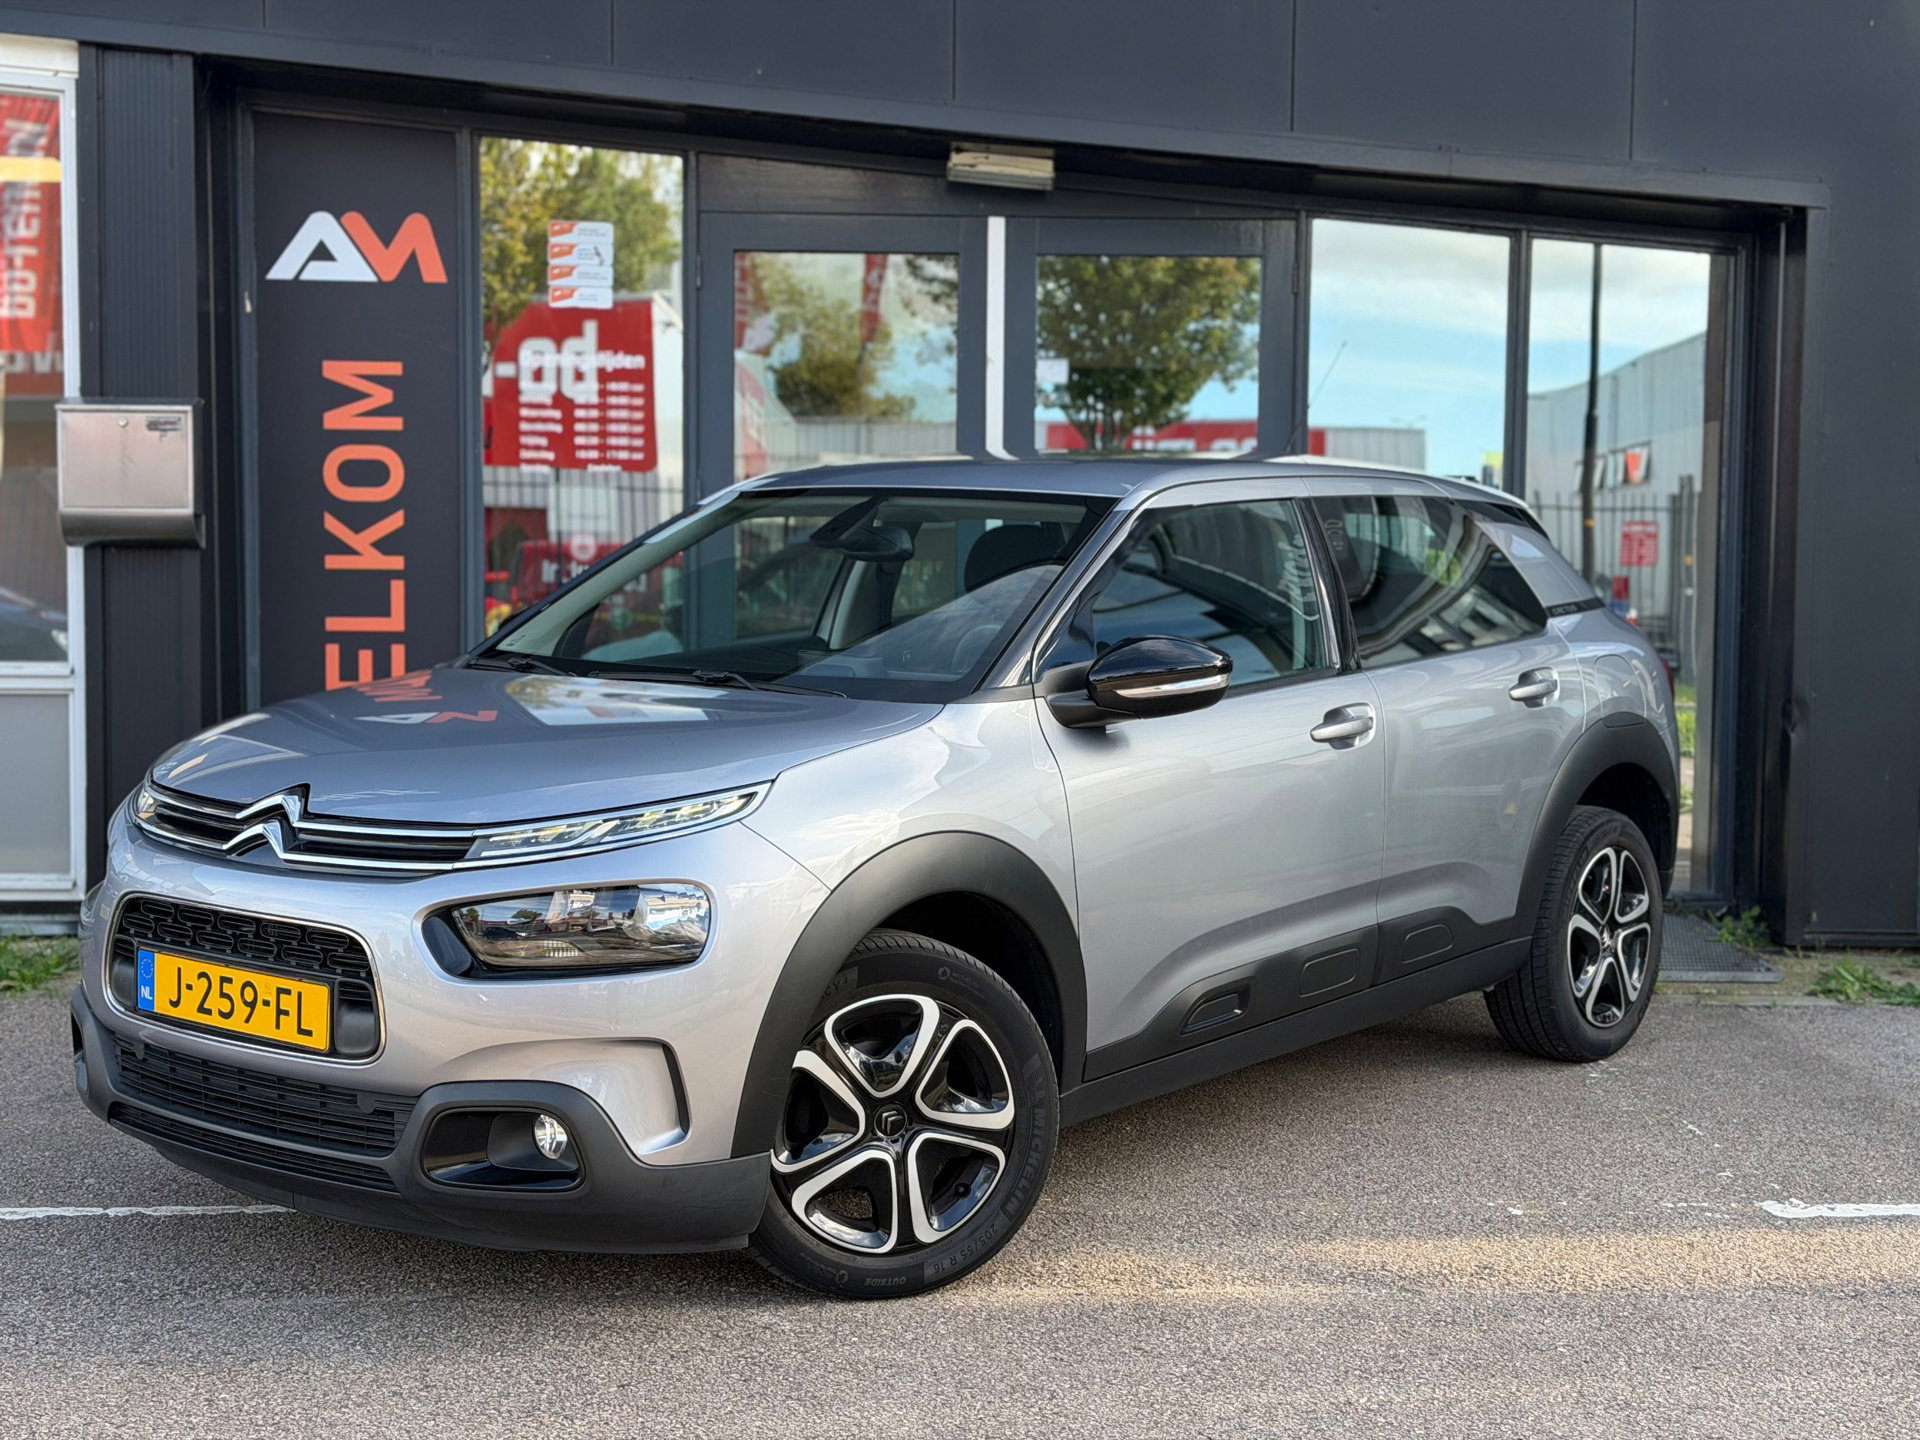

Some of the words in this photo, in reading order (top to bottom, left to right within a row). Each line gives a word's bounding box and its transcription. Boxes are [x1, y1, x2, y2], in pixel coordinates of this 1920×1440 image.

[265, 210, 449, 284] AM
[140, 984, 153, 1000] NL
[168, 966, 314, 1037] J-259-FL
[1004, 1107, 1047, 1216] MICHELIN
[864, 1276, 907, 1286] OUTSIDE
